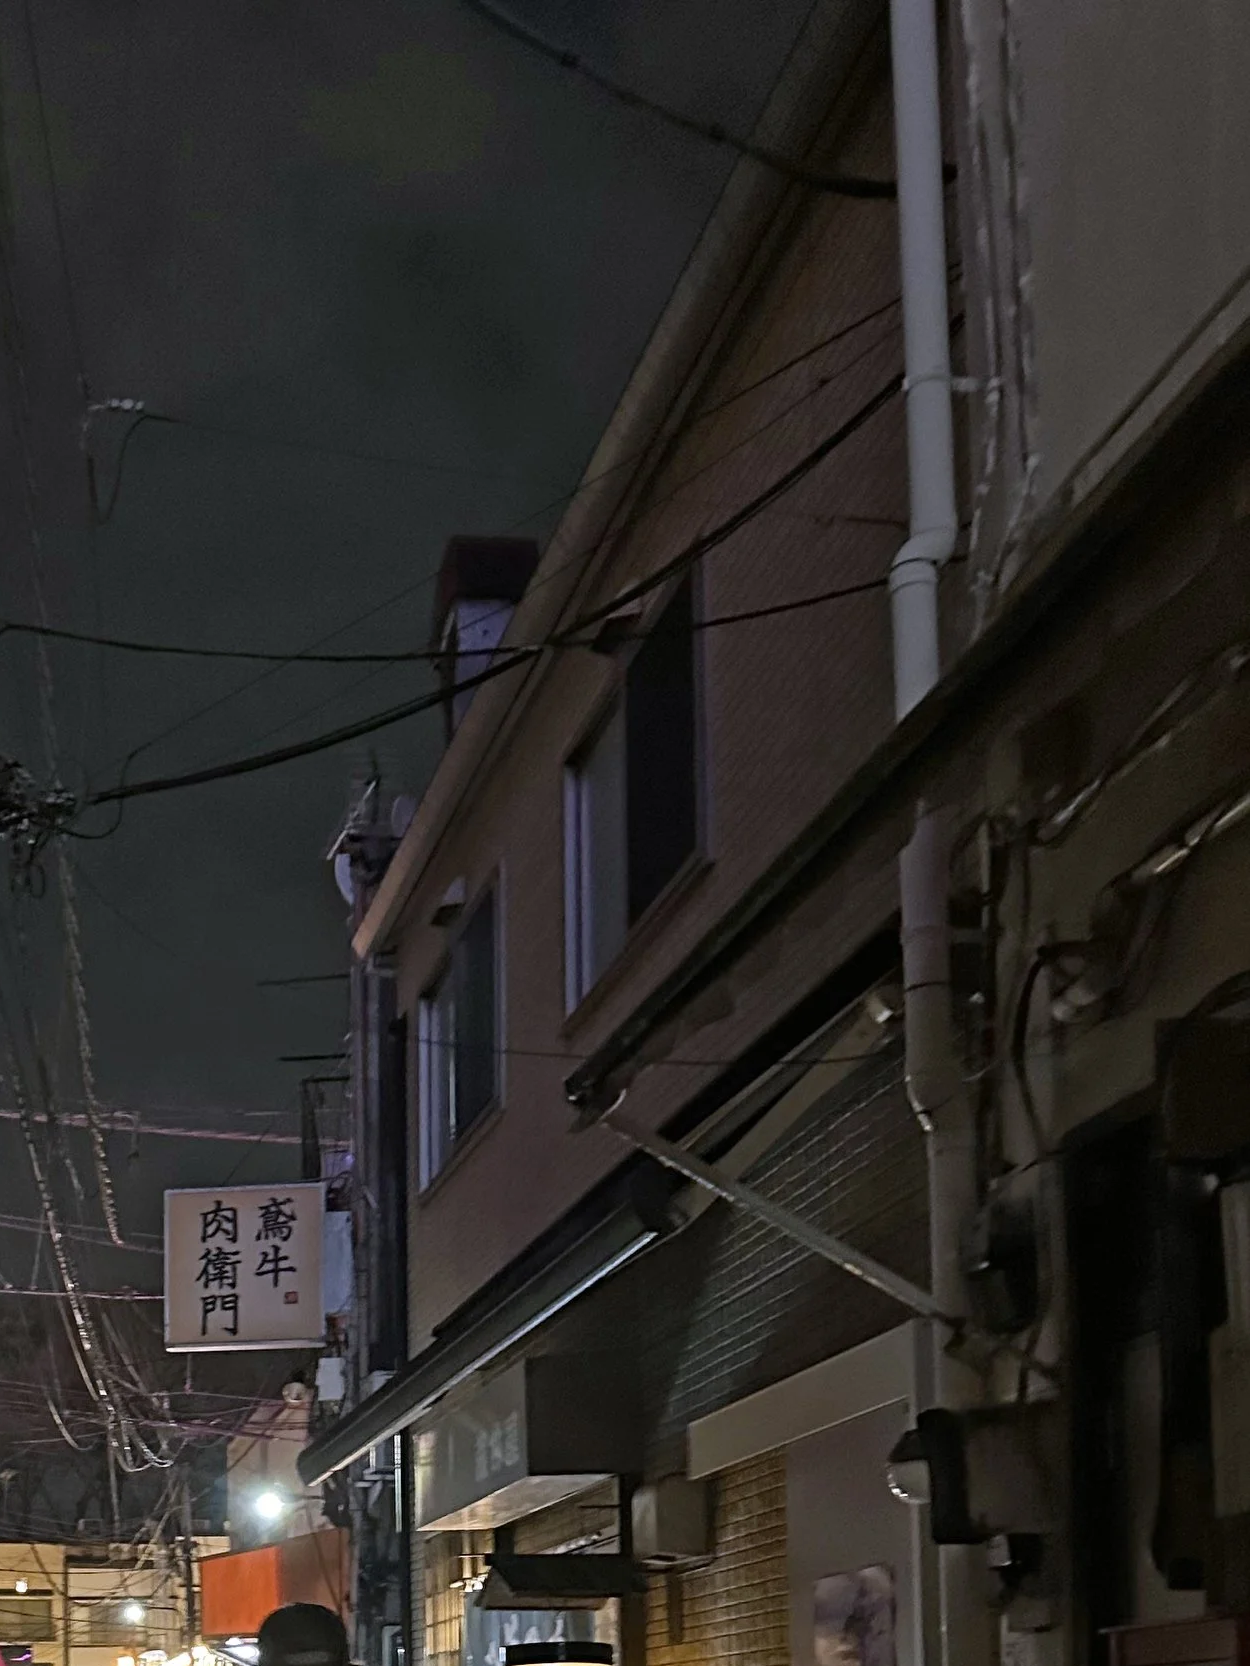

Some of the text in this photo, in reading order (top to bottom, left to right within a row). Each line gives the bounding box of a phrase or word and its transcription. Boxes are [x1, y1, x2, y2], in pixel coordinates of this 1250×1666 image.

[195, 1199, 242, 1337] 肉衛門
[254, 1196, 298, 1289] 鳶牛
